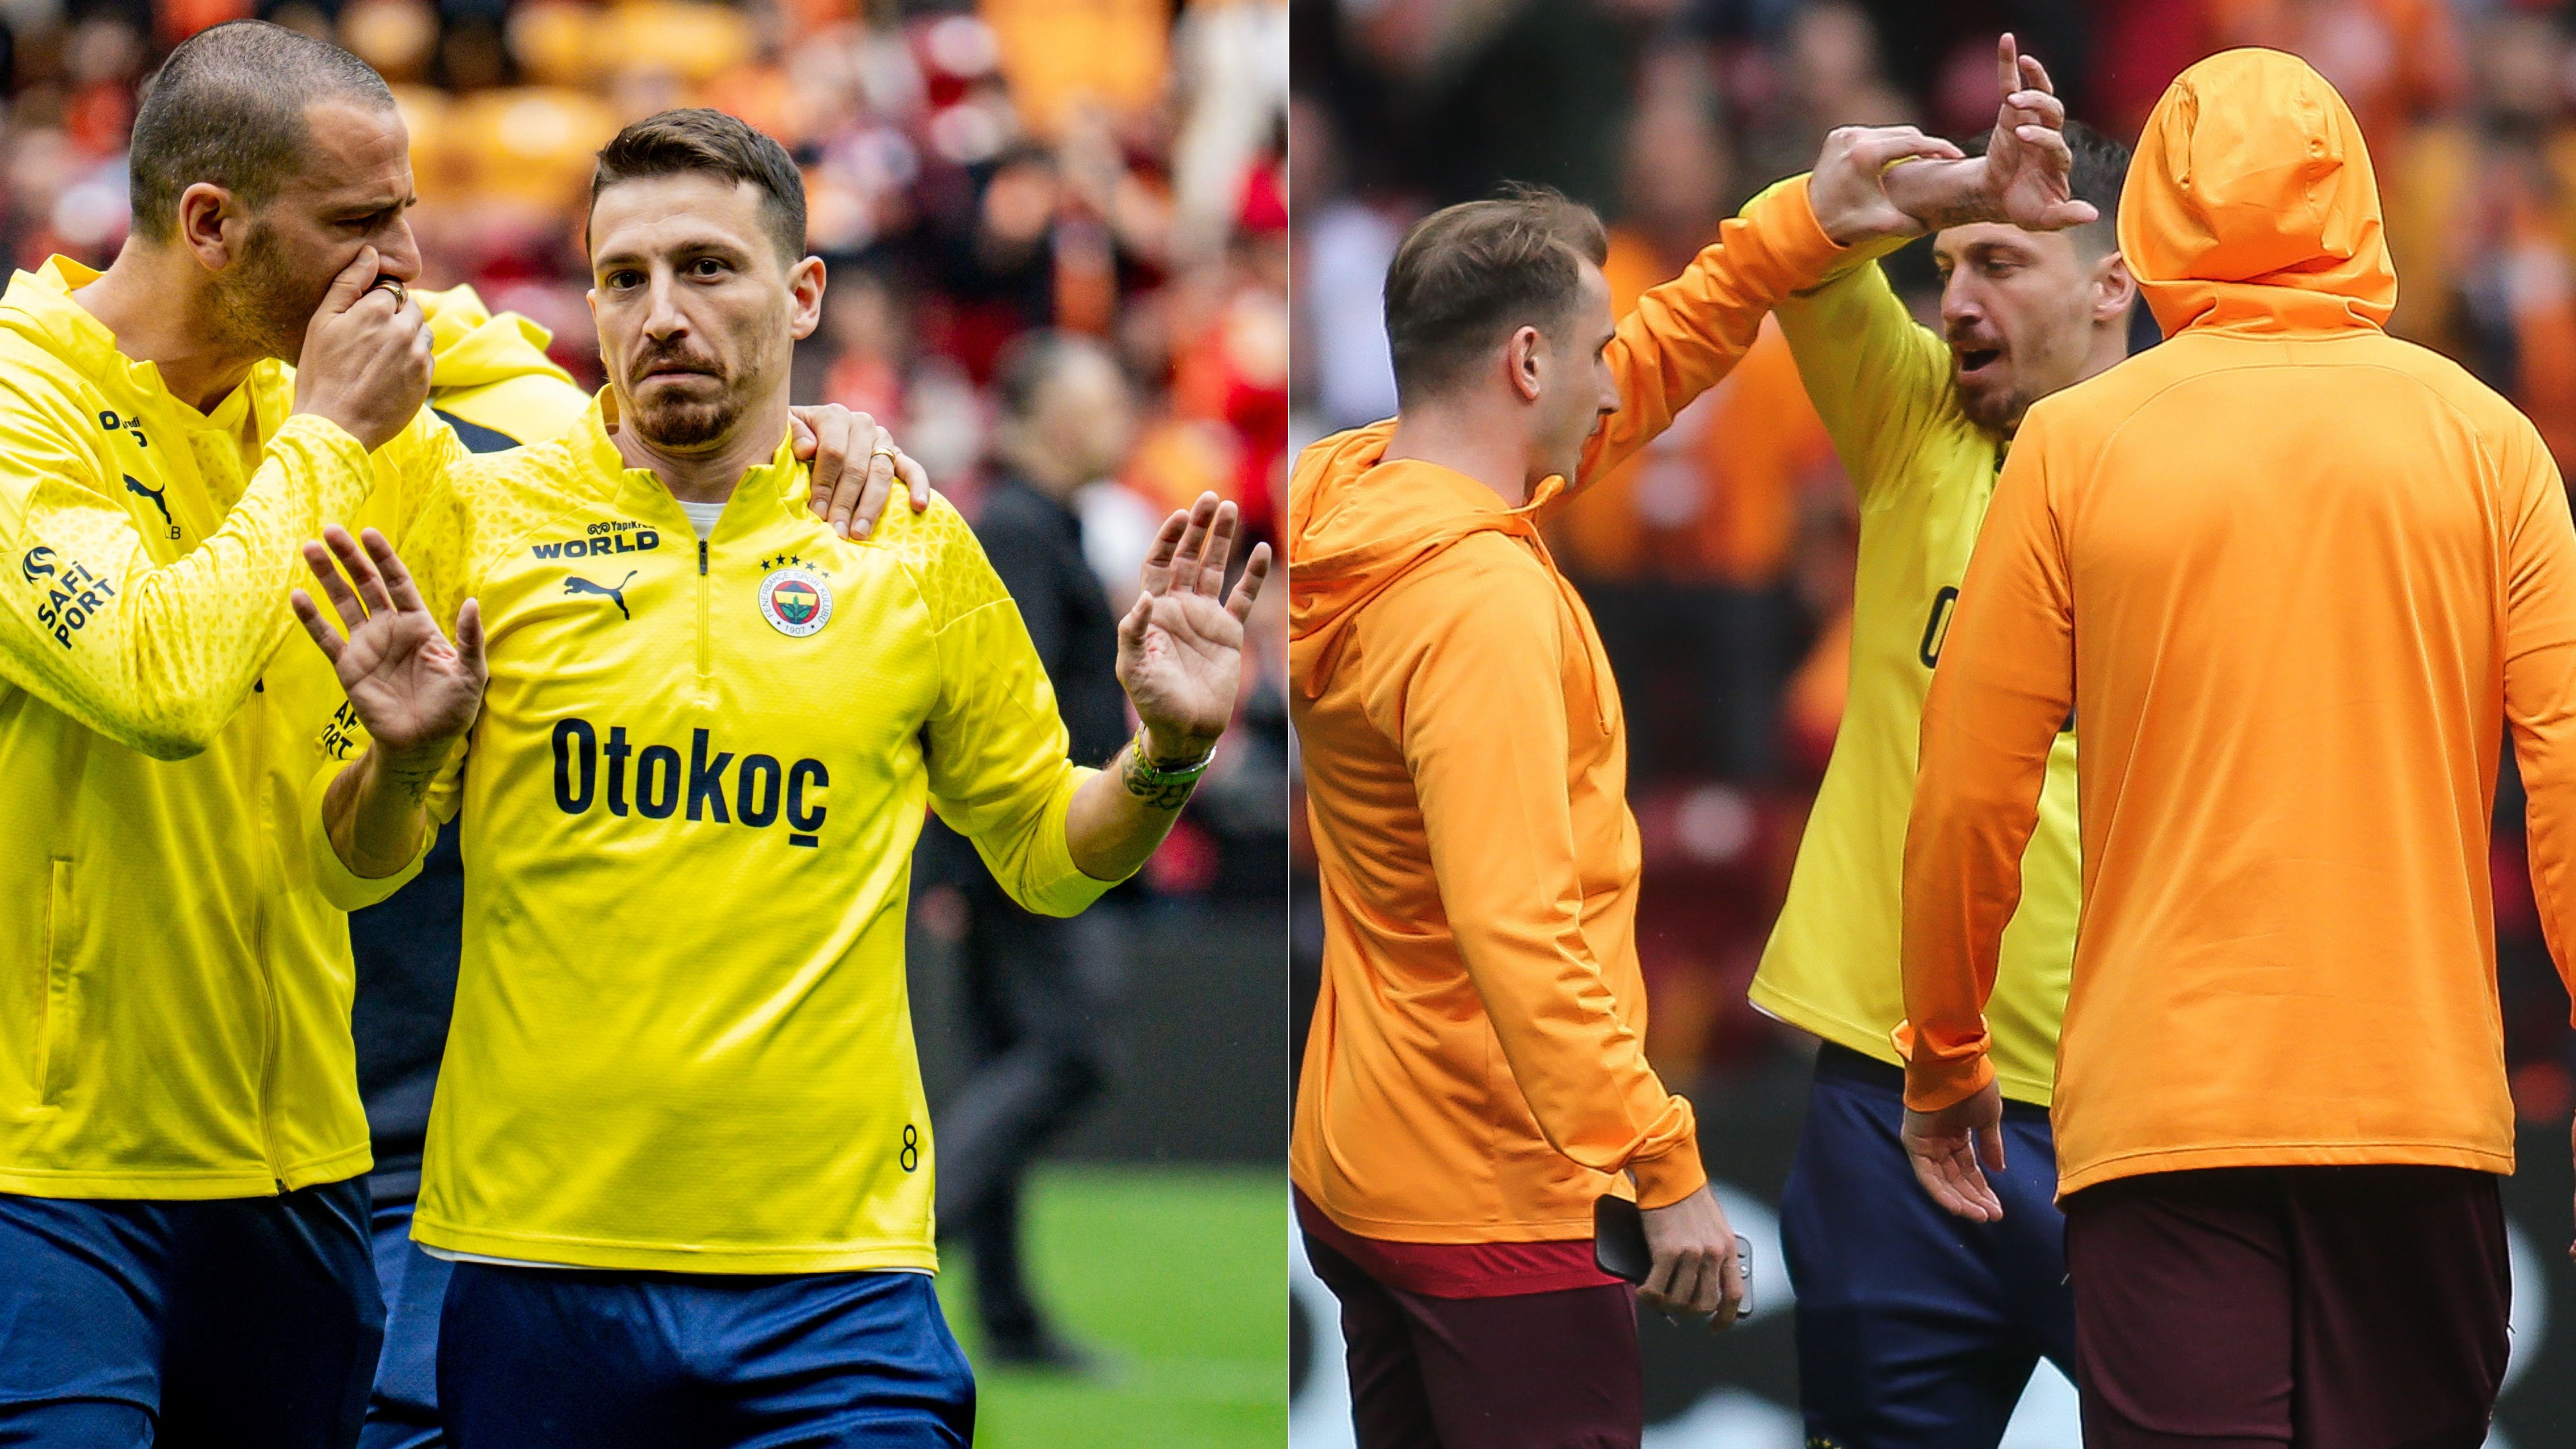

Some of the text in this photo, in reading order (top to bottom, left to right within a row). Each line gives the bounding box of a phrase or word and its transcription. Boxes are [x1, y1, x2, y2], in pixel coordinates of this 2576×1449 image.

[532, 531, 659, 559] WORLD
[54, 578, 115, 650] PORT
[761, 572, 790, 618] FENERBAHÇE
[794, 573, 820, 587] SPOR
[785, 625, 805, 635] 1907
[322, 724, 354, 759] ORT
[552, 718, 829, 848] Otokoç
[900, 1124, 917, 1172] 8
